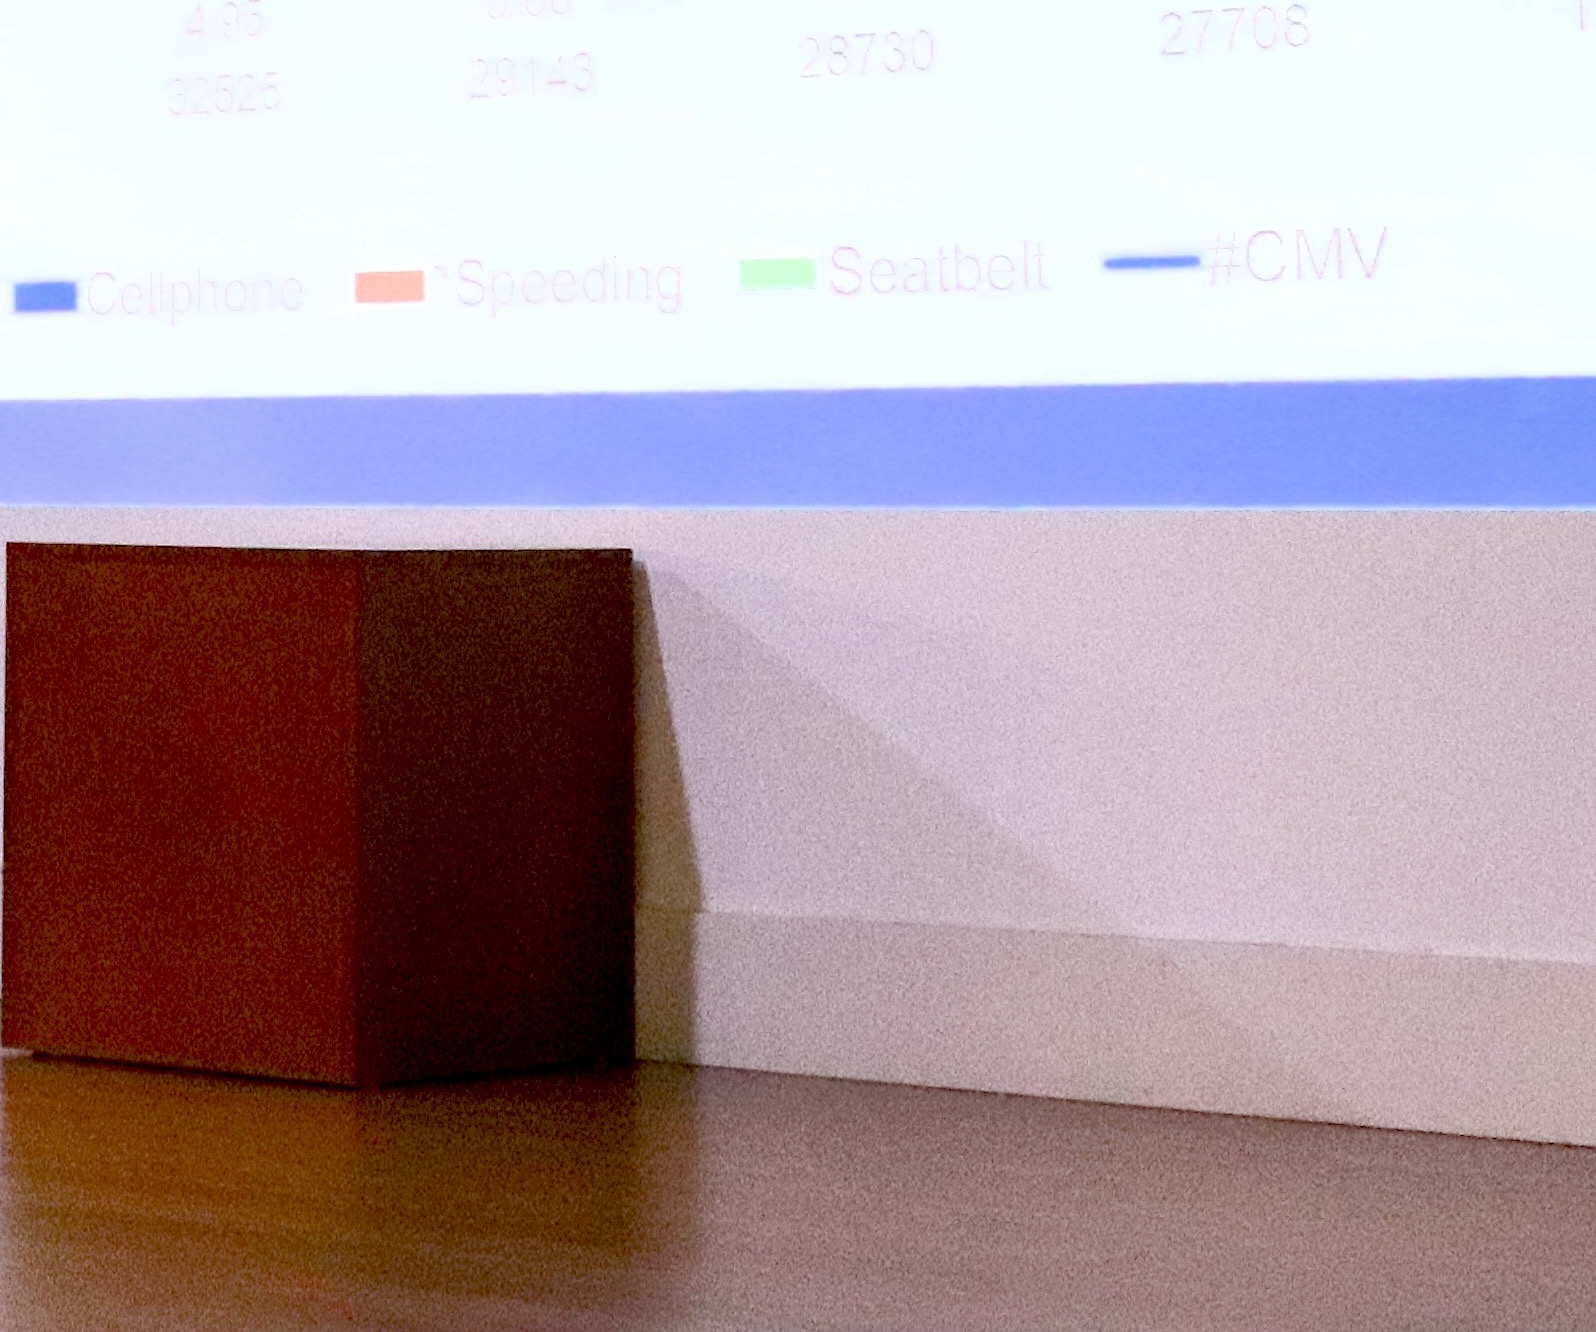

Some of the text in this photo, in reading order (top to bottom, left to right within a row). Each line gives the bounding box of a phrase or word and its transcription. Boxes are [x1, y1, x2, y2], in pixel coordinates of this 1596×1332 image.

[166, 70, 282, 118] 32525
[468, 50, 597, 101] 29143
[797, 26, 937, 79] 28730
[1158, 1, 1313, 58] 27708
[86, 270, 306, 326] Cellphone
[828, 239, 1051, 298] Seatbelt
[1207, 224, 1390, 288] #CMV
